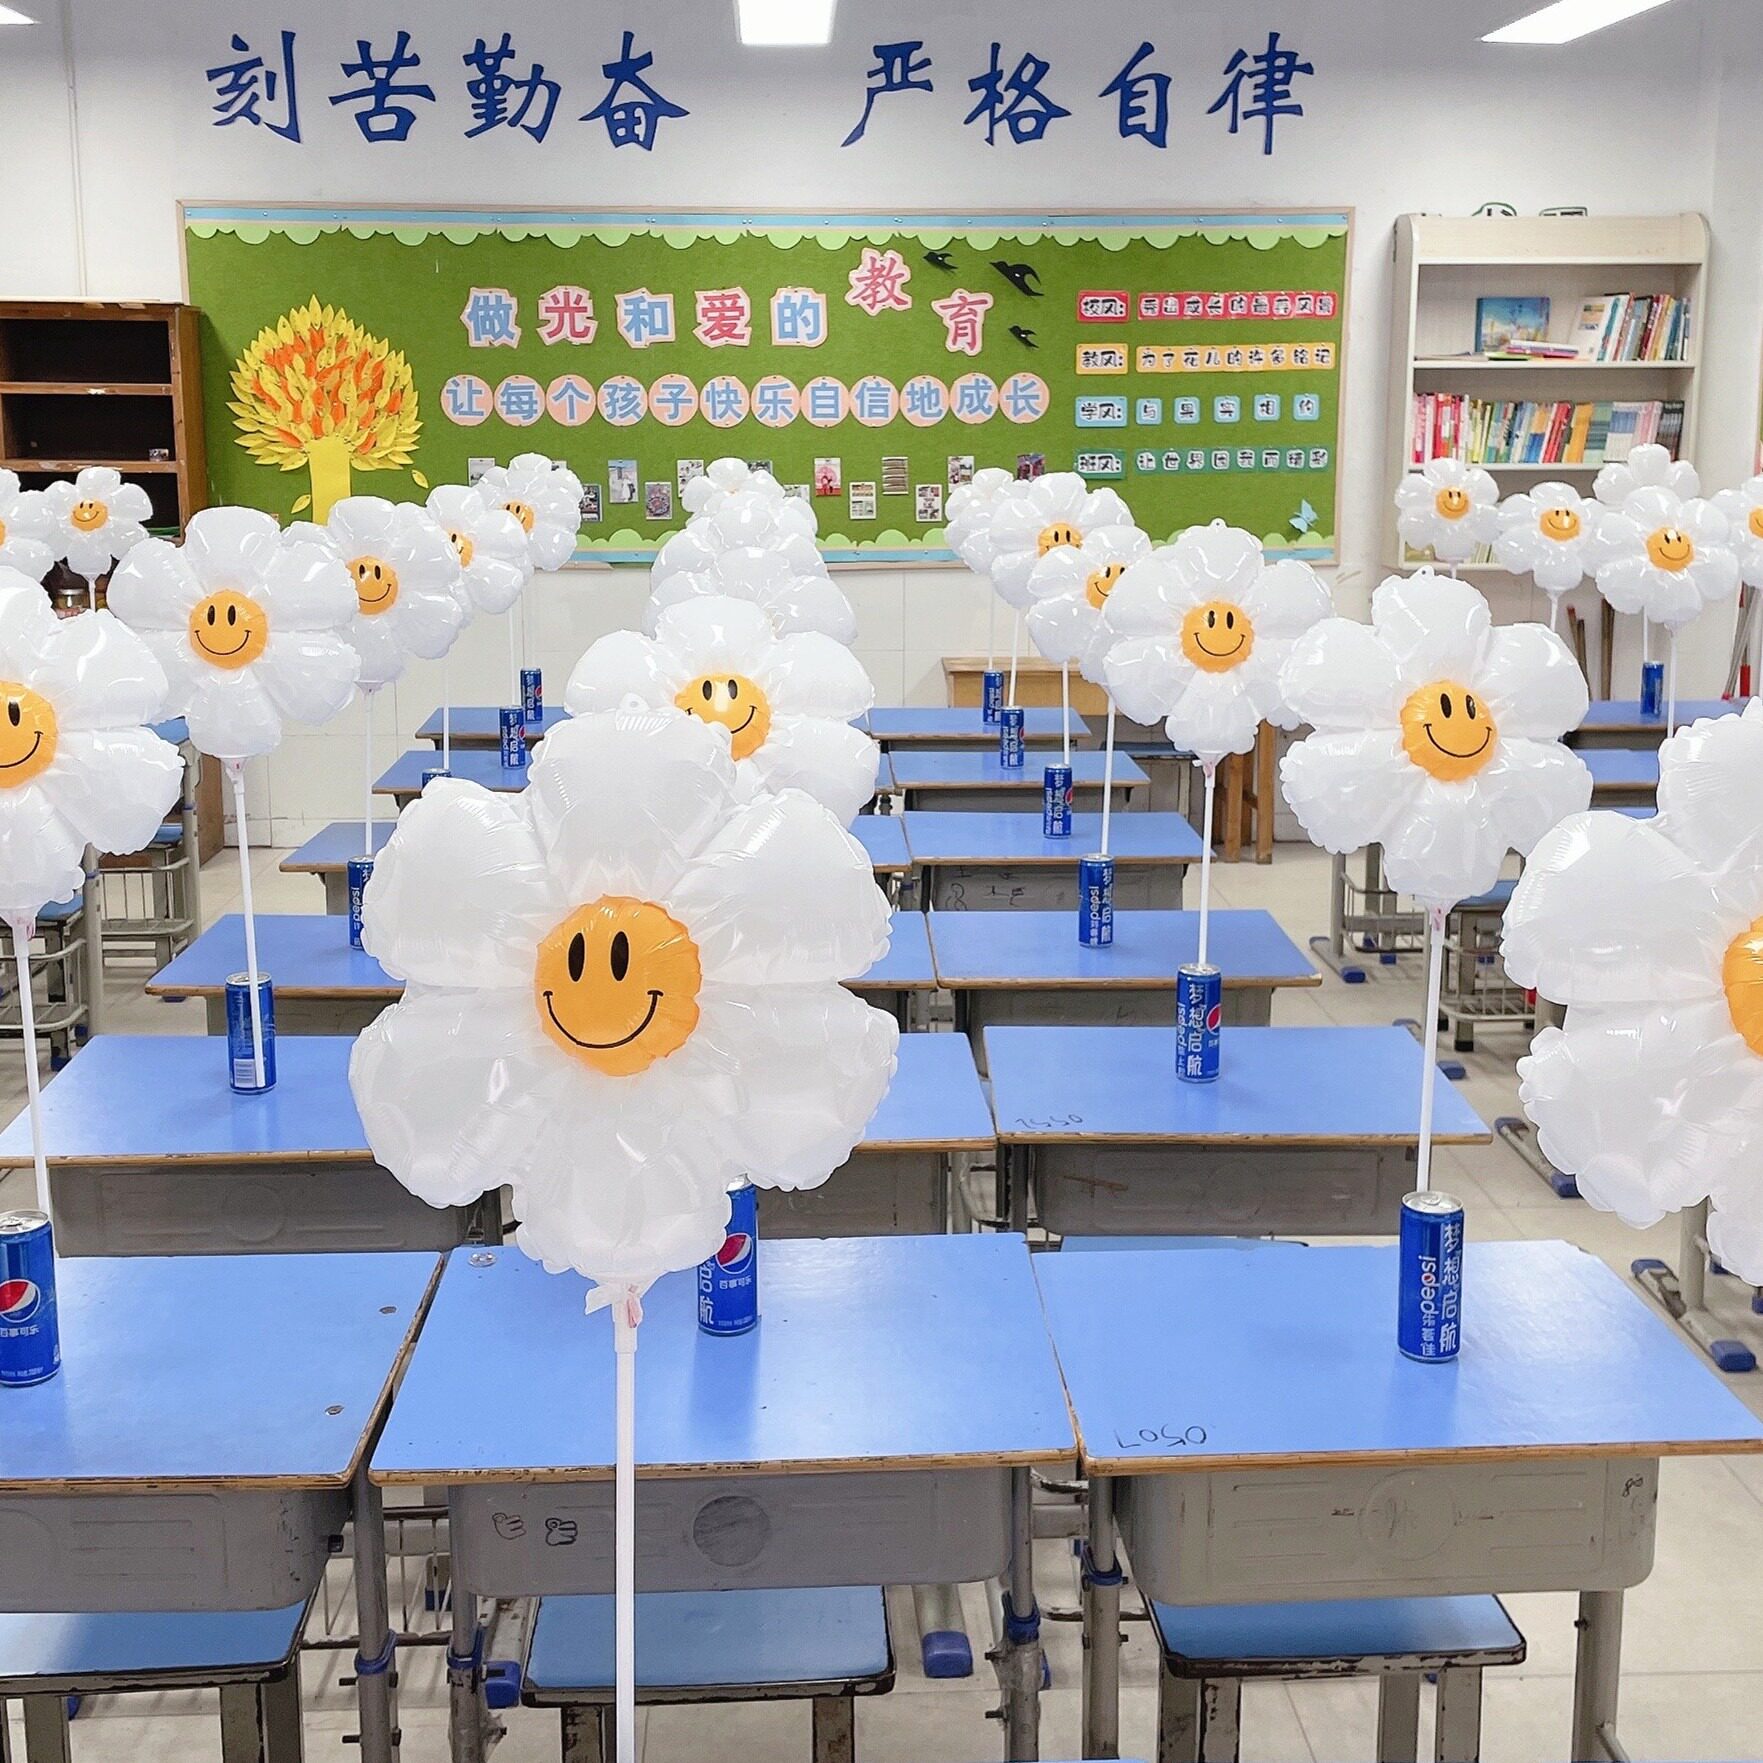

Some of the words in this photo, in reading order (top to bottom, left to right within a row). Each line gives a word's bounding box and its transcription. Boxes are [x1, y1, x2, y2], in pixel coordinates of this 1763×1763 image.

[206, 30, 691, 151] 刻苦勤奋
[840, 31, 1315, 155] 严格自律
[467, 256, 989, 351] 做光和爱的教育
[446, 378, 1042, 421] 让每个孩子快乐自信地成长
[1080, 402, 1122, 420] 学风：
[1187, 983, 1204, 1076] 梦想启航
[1418, 1254, 1440, 1314] pepsi
[1440, 1223, 1460, 1353] 梦想启航
